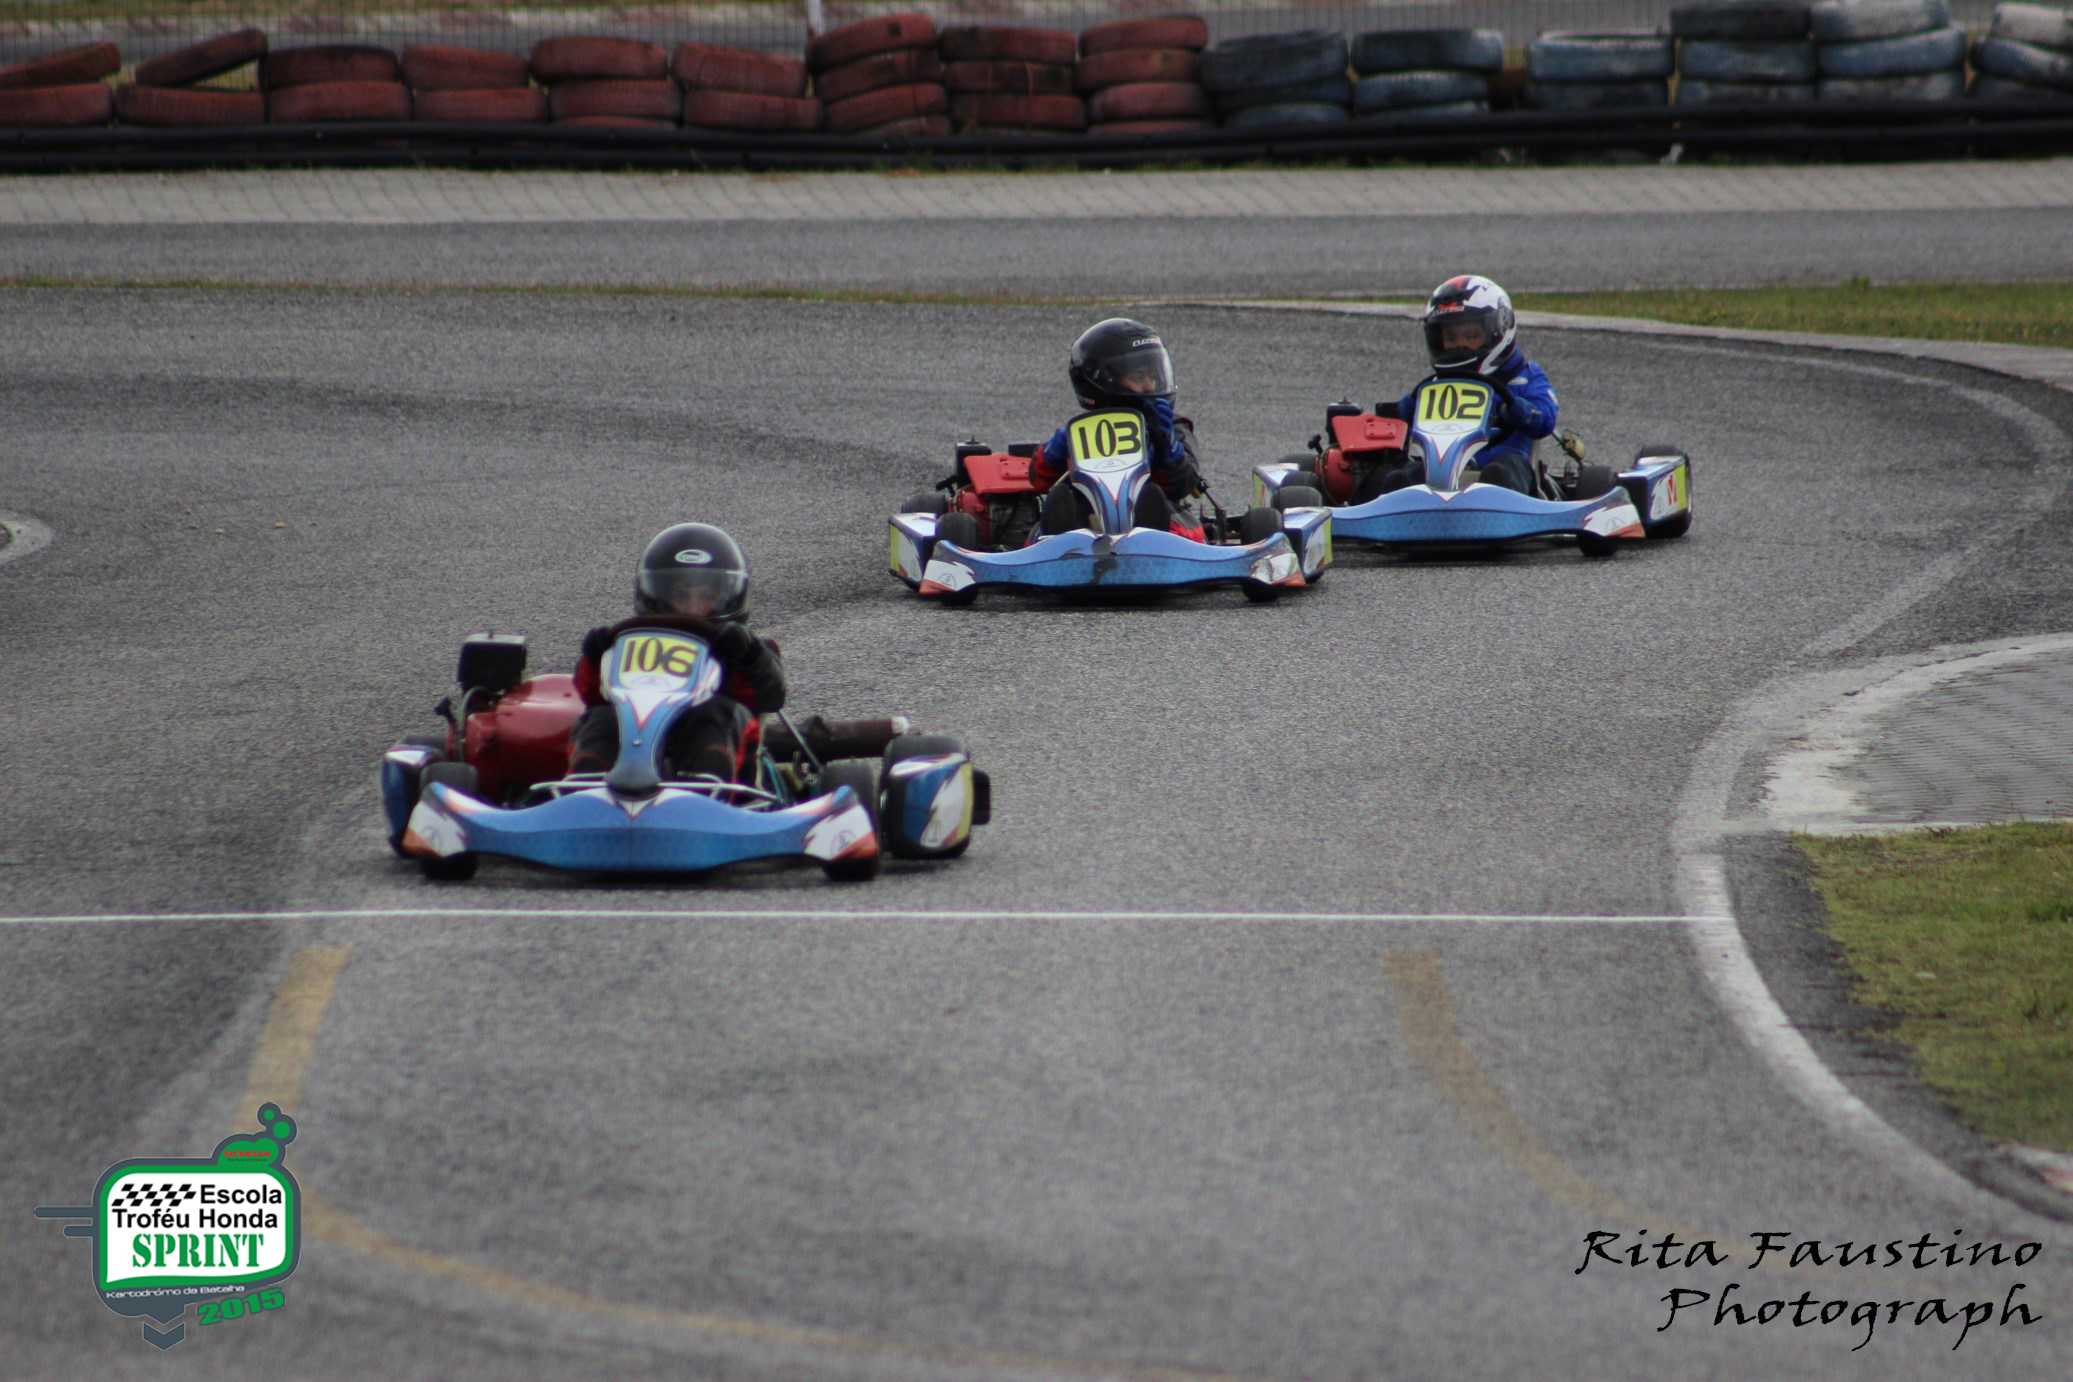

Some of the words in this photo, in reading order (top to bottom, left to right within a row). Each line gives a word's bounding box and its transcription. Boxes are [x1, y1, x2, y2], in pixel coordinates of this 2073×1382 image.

[1425, 384, 1486, 420] 102
[1078, 419, 1142, 460] 103
[623, 637, 698, 678] 106
